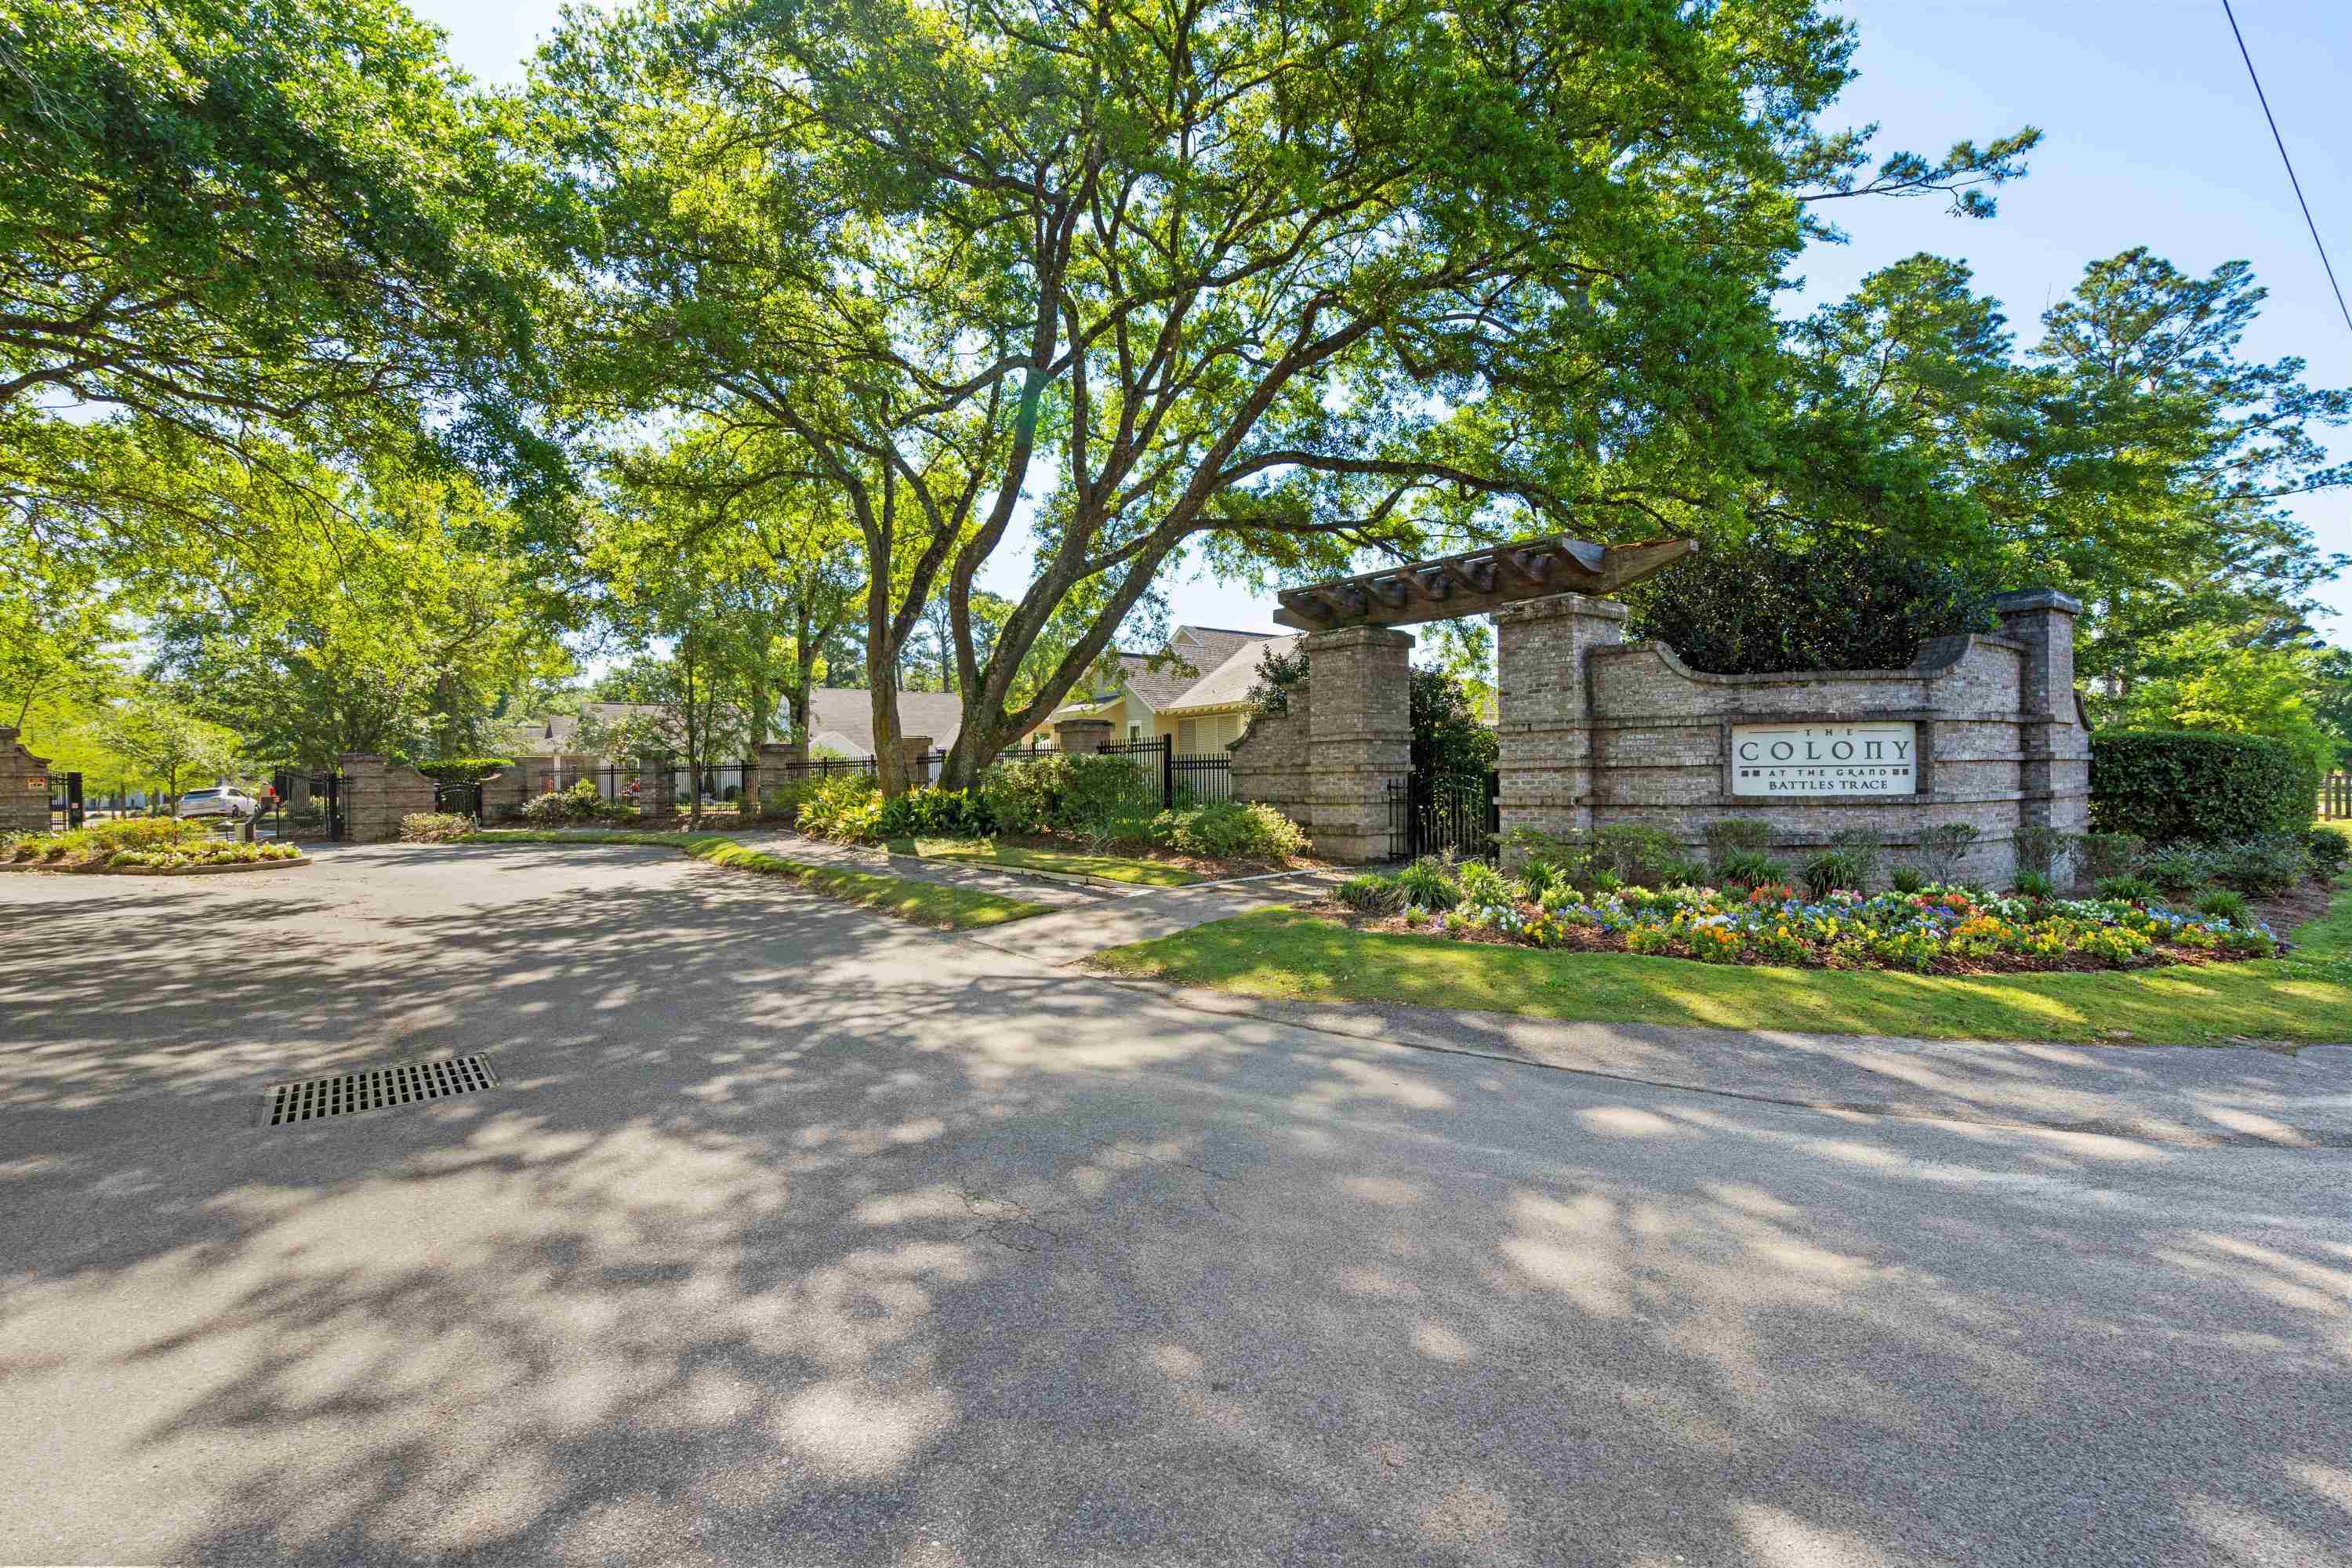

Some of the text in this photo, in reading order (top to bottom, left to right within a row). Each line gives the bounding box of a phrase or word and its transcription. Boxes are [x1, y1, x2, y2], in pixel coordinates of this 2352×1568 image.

[1740, 741, 1910, 760] COLONY
[1836, 768, 1886, 777] GRAND
[1769, 780, 1888, 790] BATTLES TRACE
